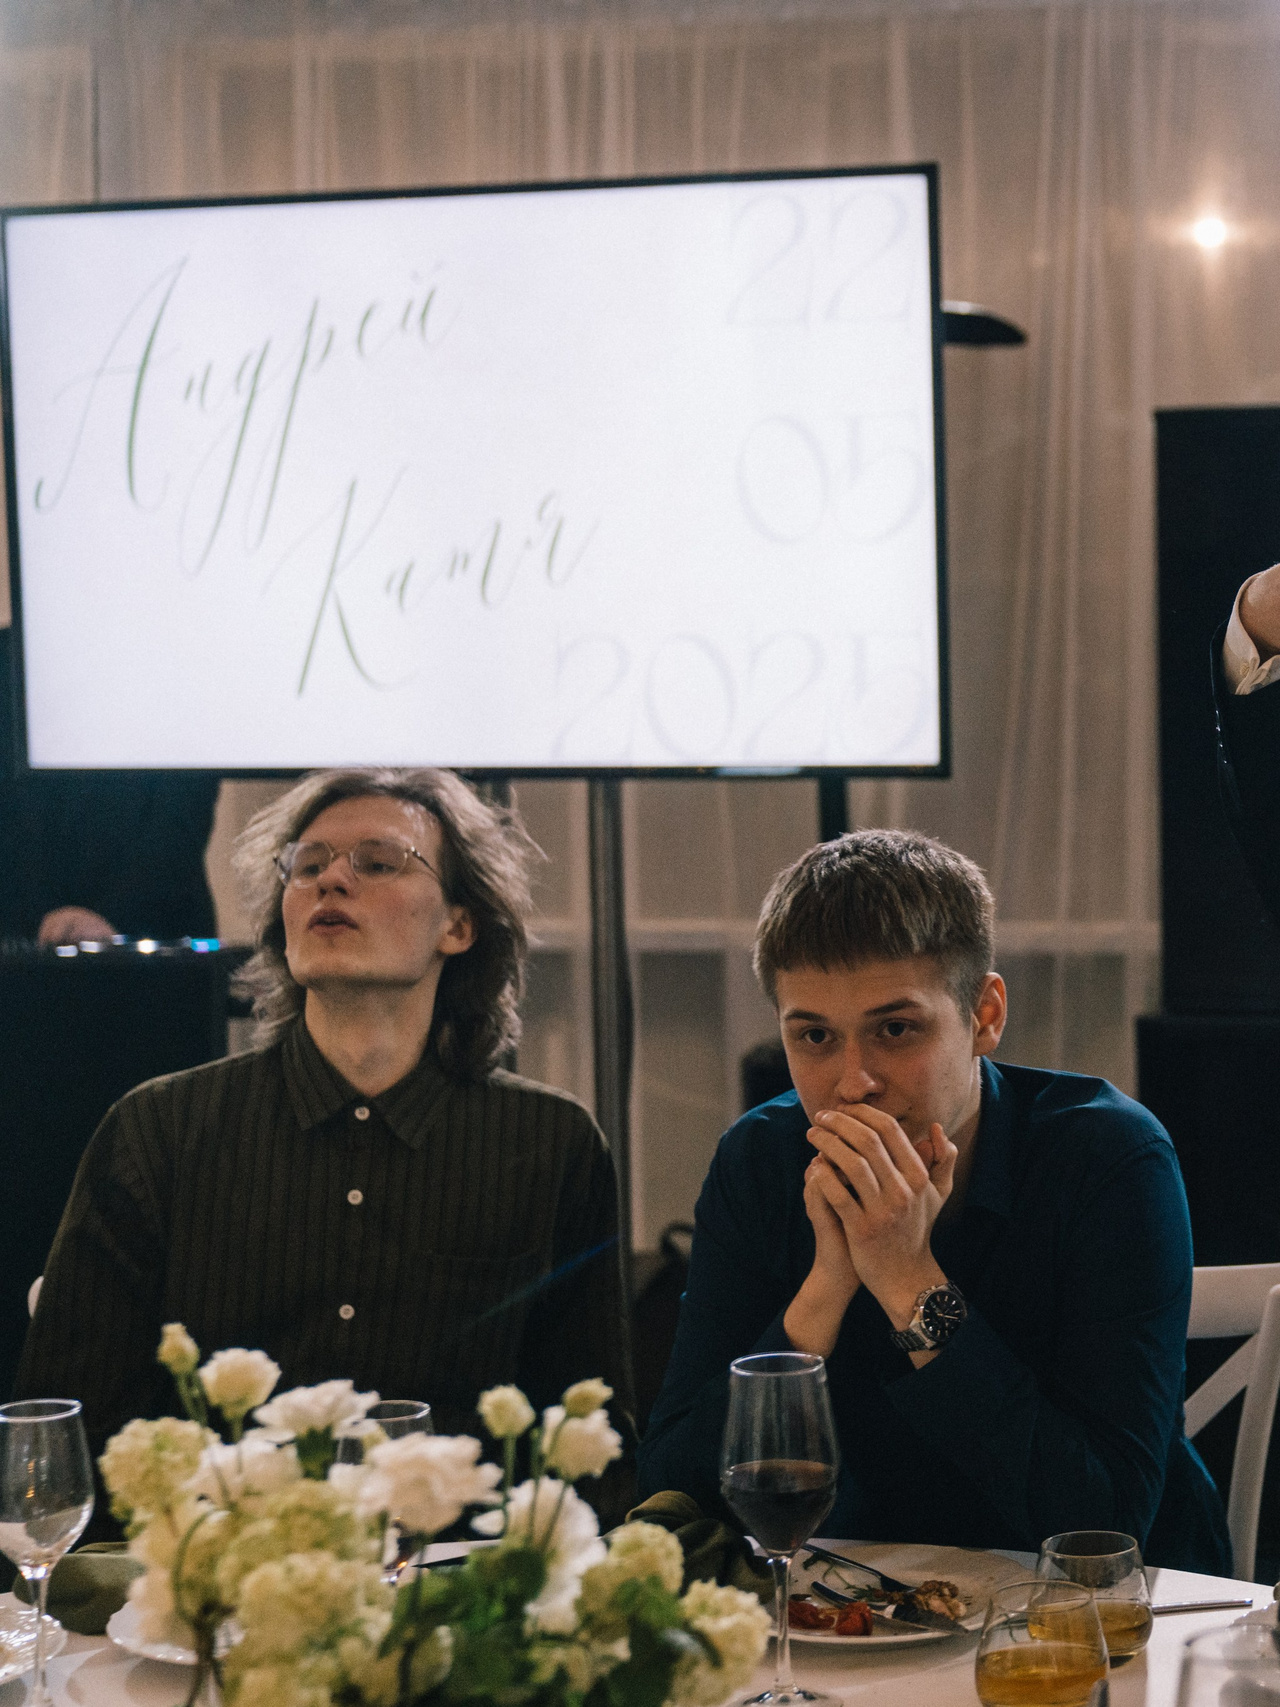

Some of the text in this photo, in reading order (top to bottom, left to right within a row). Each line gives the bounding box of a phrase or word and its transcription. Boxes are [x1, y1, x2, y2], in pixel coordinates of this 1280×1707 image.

[723, 190, 914, 331] 22
[33, 253, 462, 581] Андрей
[734, 410, 927, 545] 05
[260, 461, 600, 699] Катя
[551, 622, 932, 764] 2025
